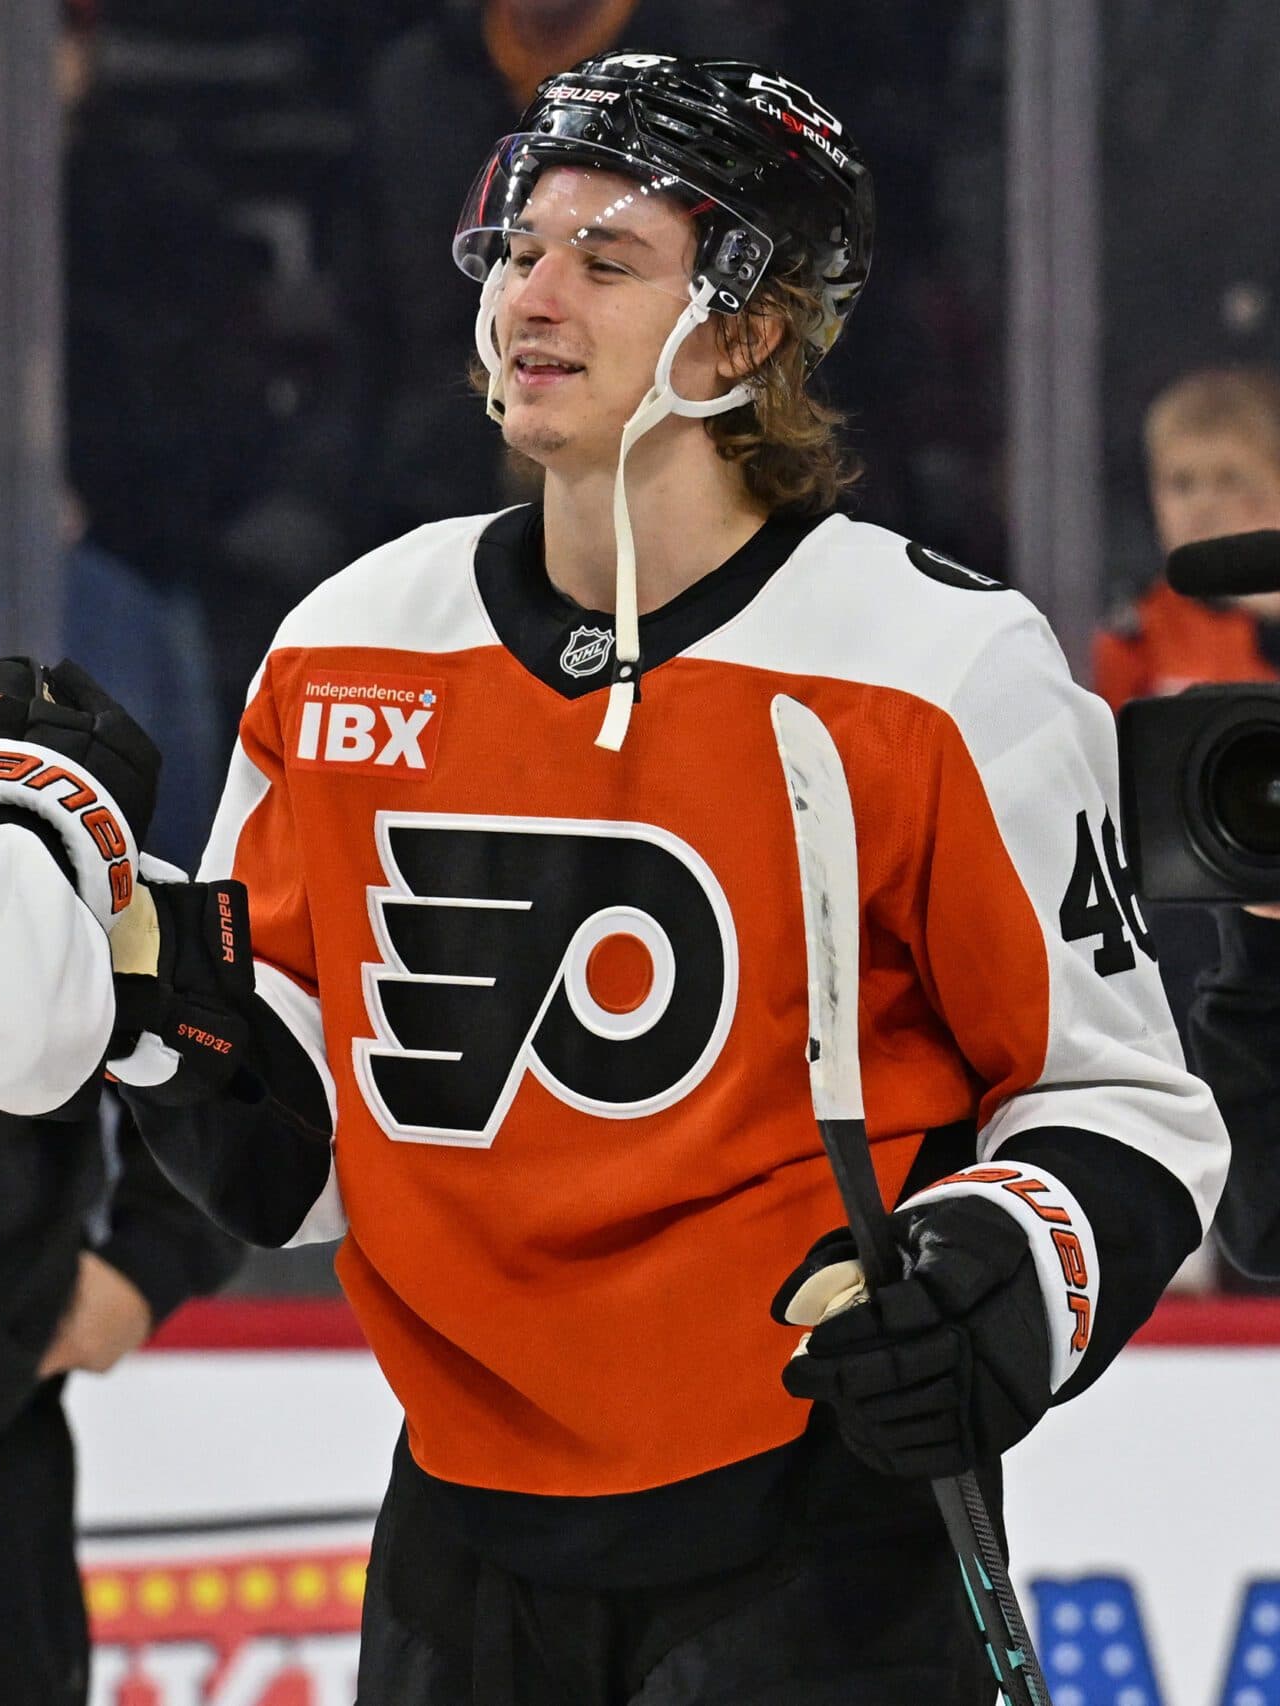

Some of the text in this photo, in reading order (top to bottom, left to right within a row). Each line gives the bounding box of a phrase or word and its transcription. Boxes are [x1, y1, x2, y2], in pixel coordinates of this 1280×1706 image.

[544, 85, 620, 105] BAUER
[755, 97, 849, 169] CHEVROLET
[569, 642, 603, 665] NHL
[305, 681, 415, 704] Independence
[296, 701, 436, 770] IBX
[217, 892, 235, 964] BAUER
[177, 1022, 233, 1055] ZEGRAS
